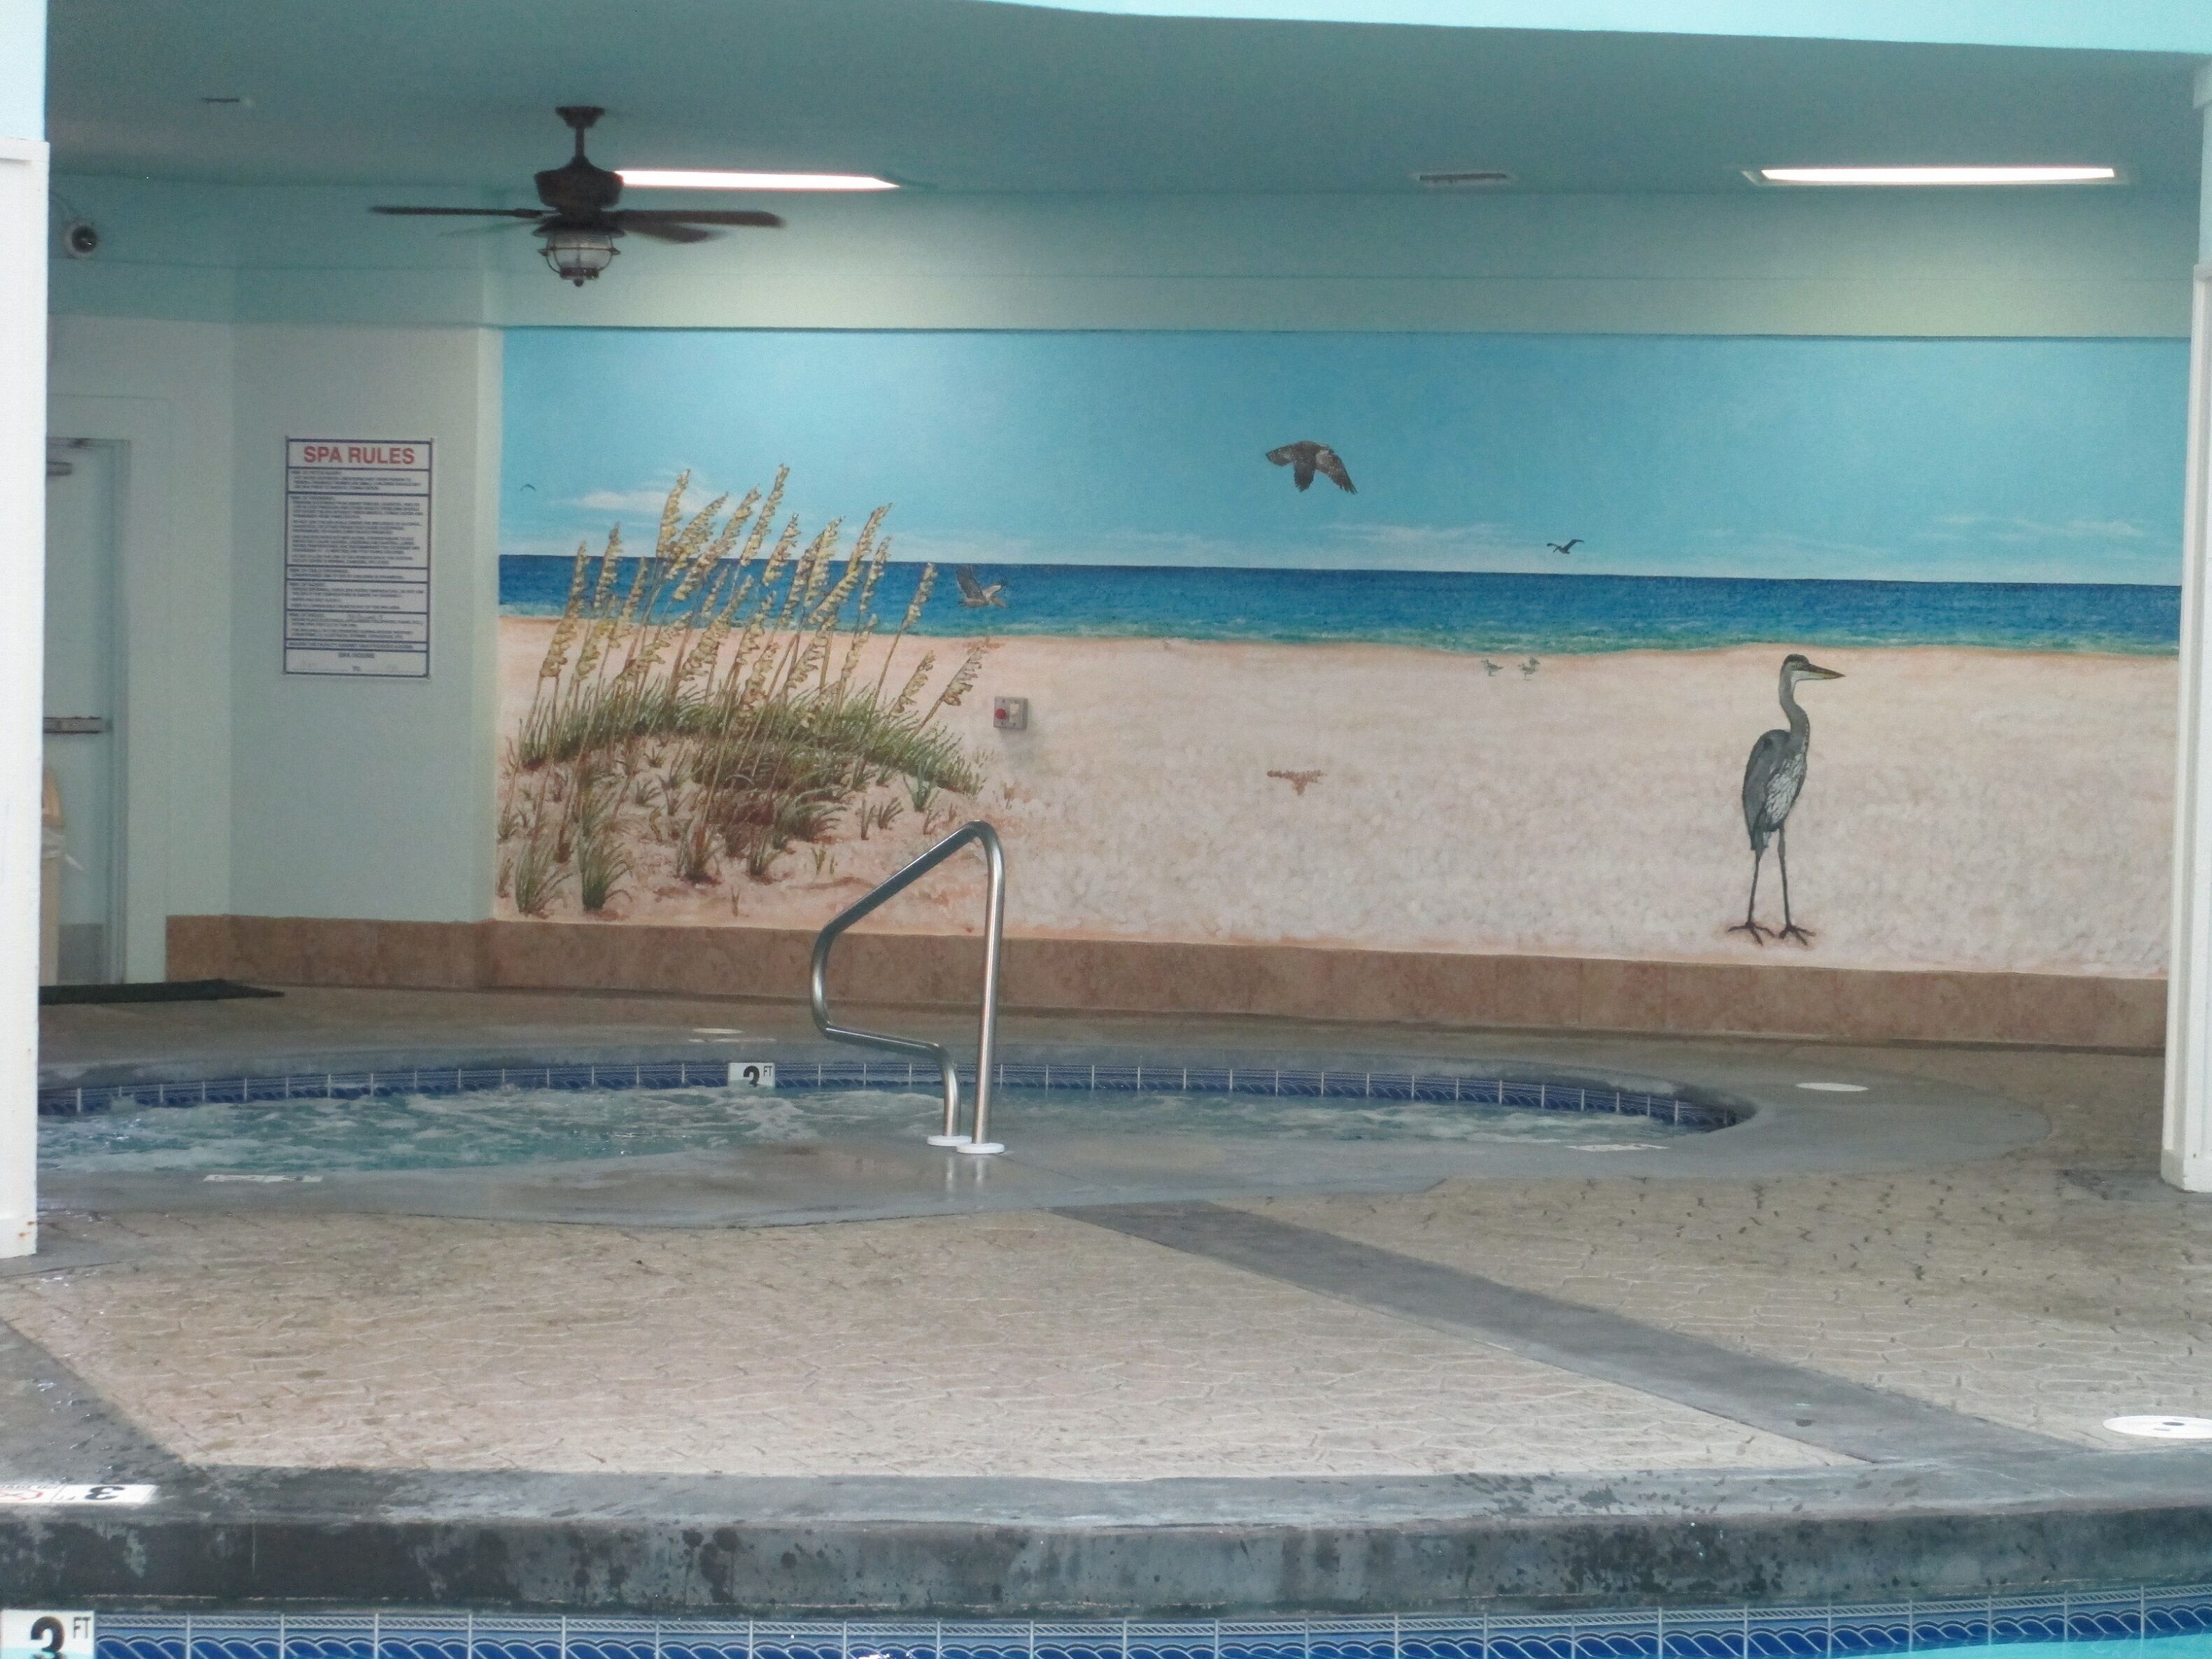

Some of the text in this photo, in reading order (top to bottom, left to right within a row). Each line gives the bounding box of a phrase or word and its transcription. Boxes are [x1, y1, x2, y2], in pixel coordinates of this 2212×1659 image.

[304, 446, 415, 464] SPA RULES
[763, 1065, 773, 1076] FT
[84, 1486, 125, 1500] 3
[73, 1616, 91, 1639] FT
